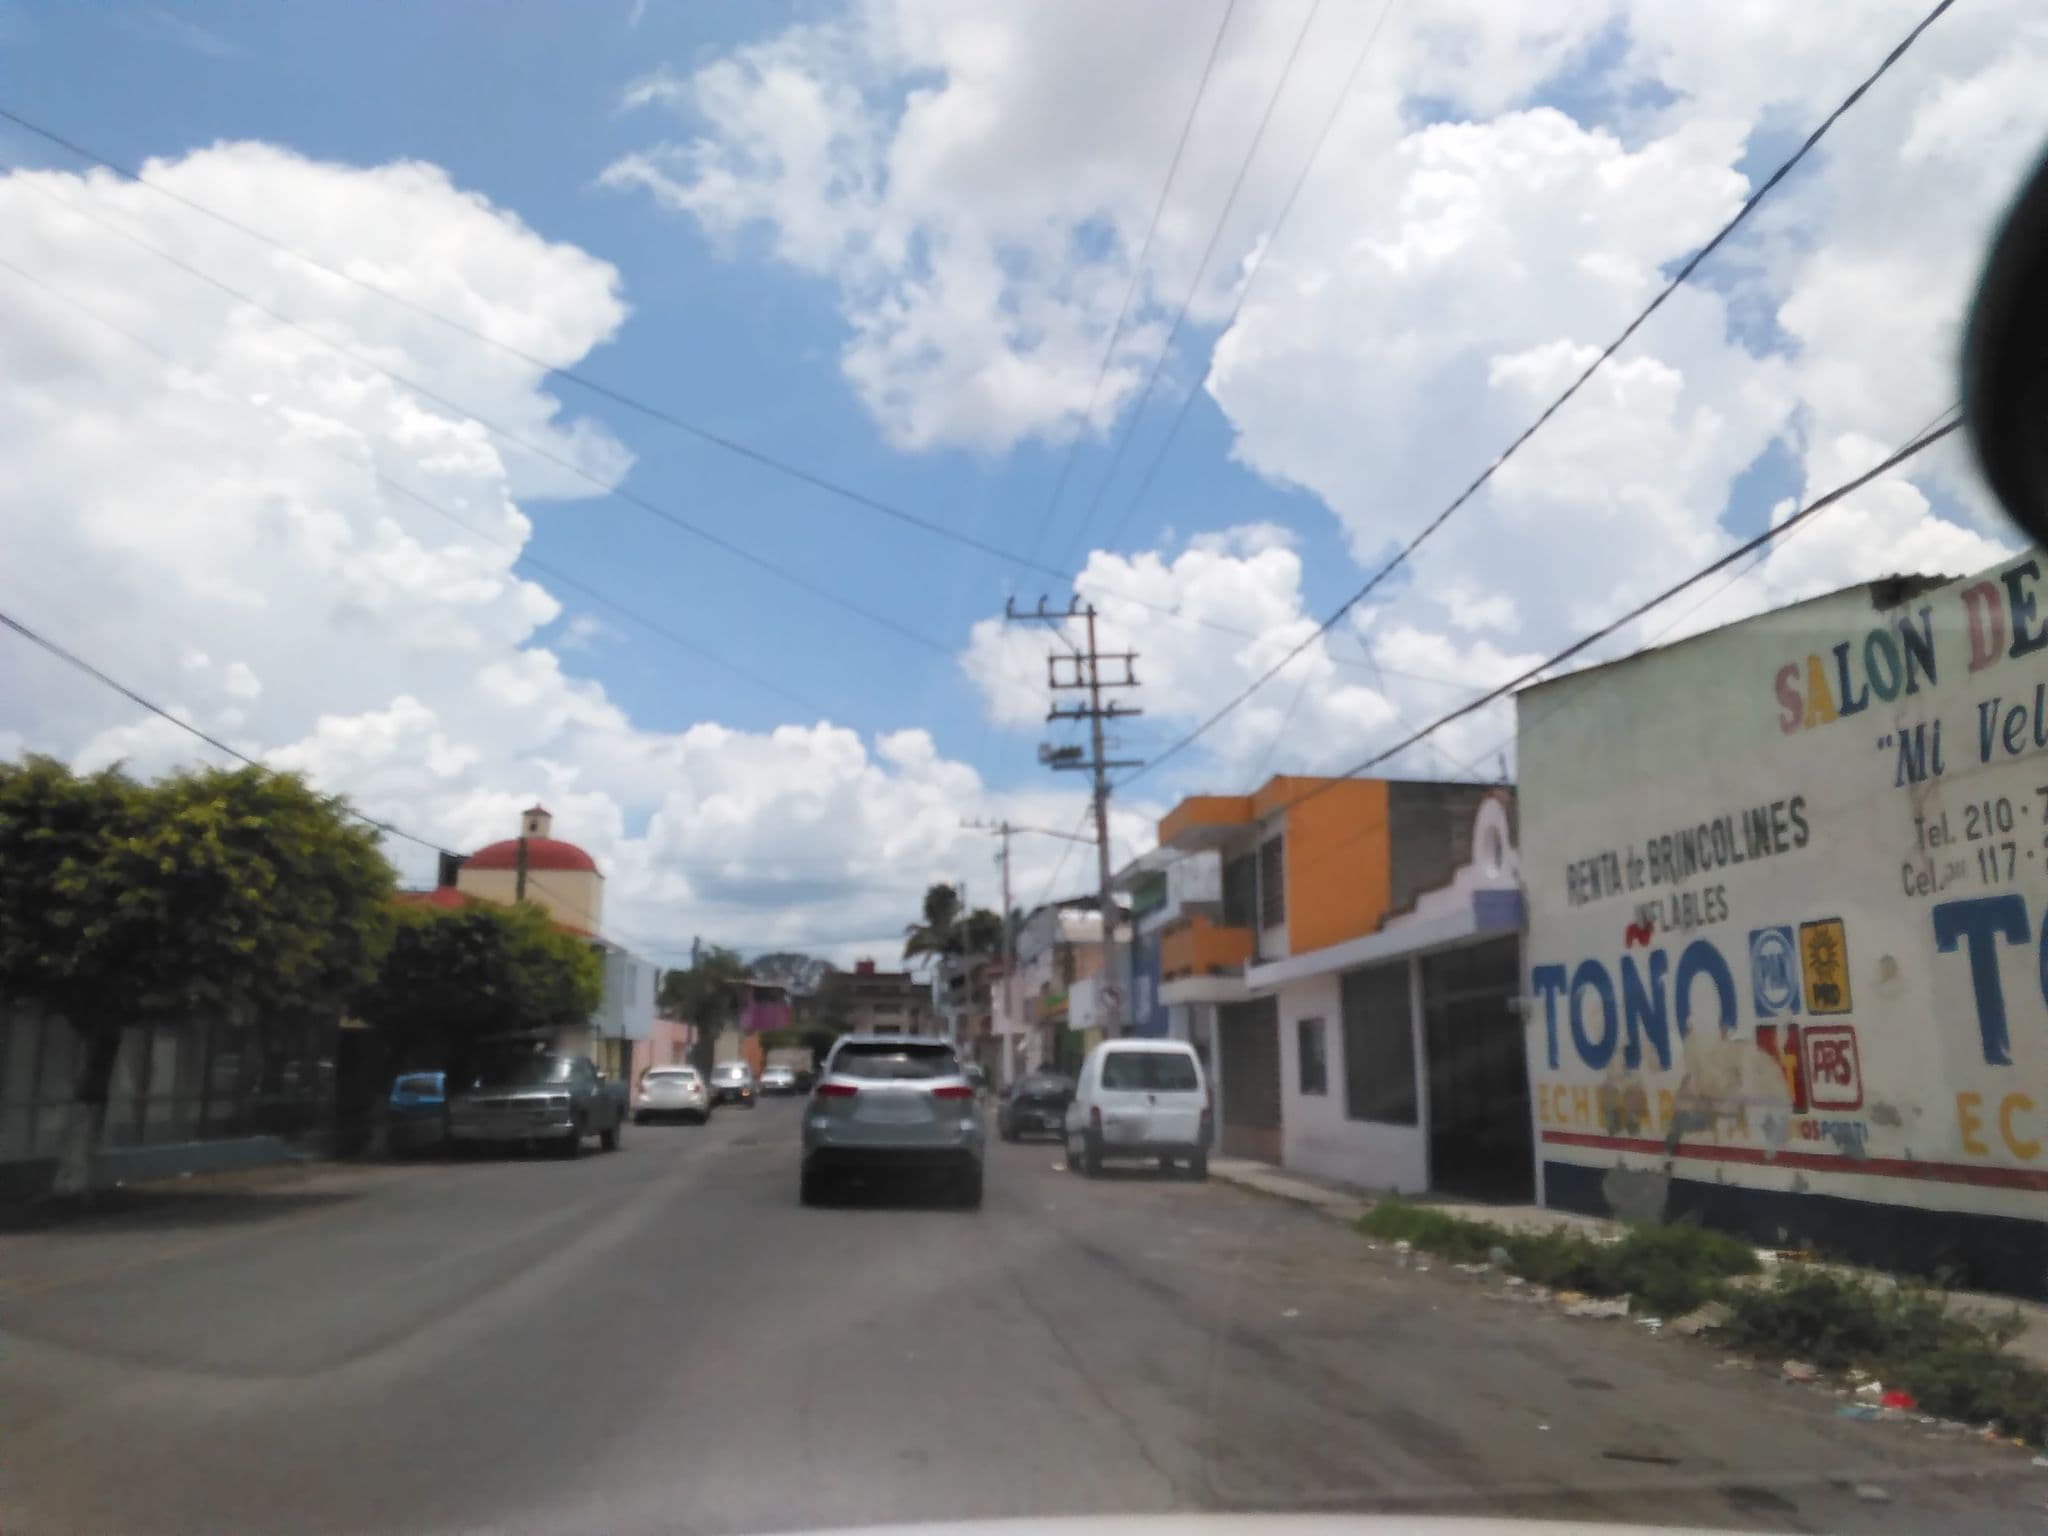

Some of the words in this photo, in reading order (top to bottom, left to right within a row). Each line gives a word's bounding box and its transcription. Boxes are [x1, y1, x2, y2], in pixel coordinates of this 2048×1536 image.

[1775, 606, 1937, 734] SALON
[1961, 560, 2048, 673] DE
[1567, 850, 1624, 907] RENTA
[1647, 795, 1810, 886] BRINCOLINES
